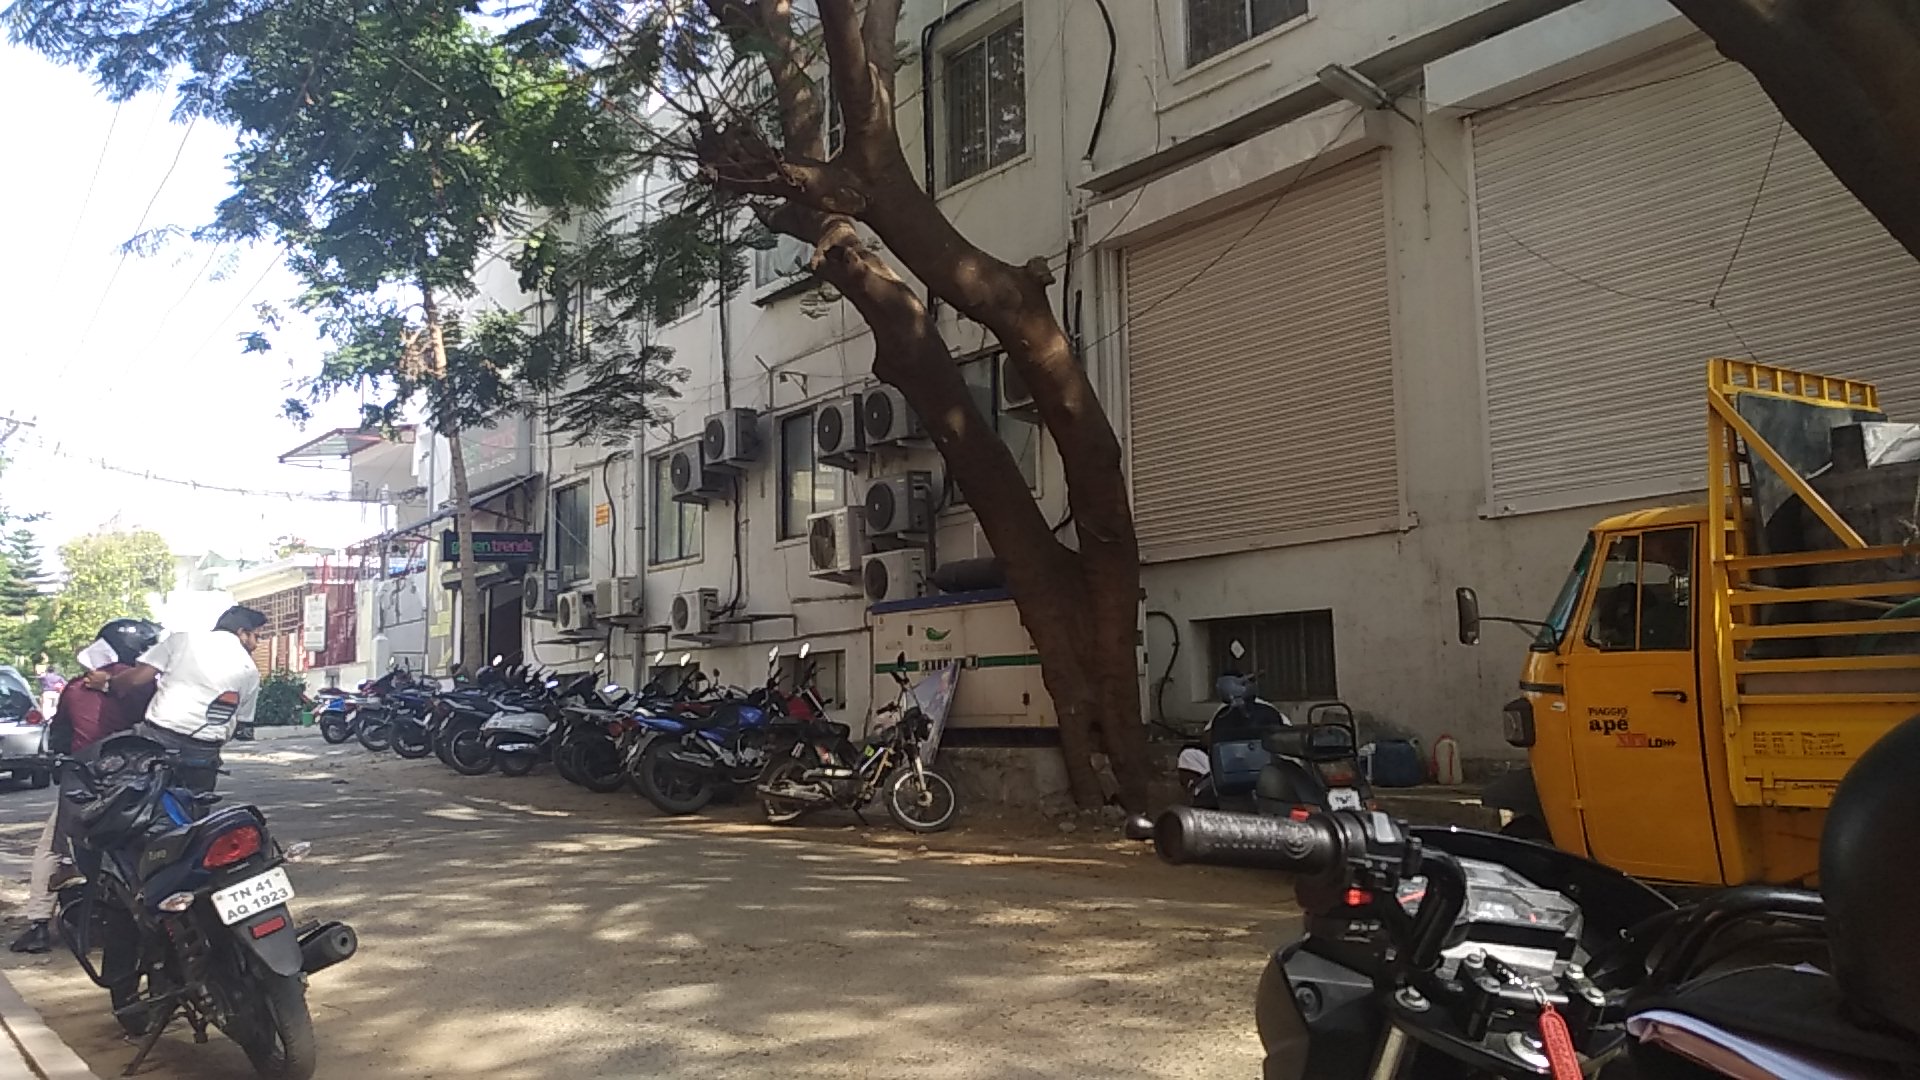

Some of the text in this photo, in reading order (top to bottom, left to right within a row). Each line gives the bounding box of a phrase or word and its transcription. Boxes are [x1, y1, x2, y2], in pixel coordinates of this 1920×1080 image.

[451, 539, 534, 555] gen trends
[1588, 707, 1628, 717] PIAGGIO
[1589, 718, 1628, 735] ape
[228, 878, 274, 903] TN 41
[227, 887, 289, 921] AQ 1923
